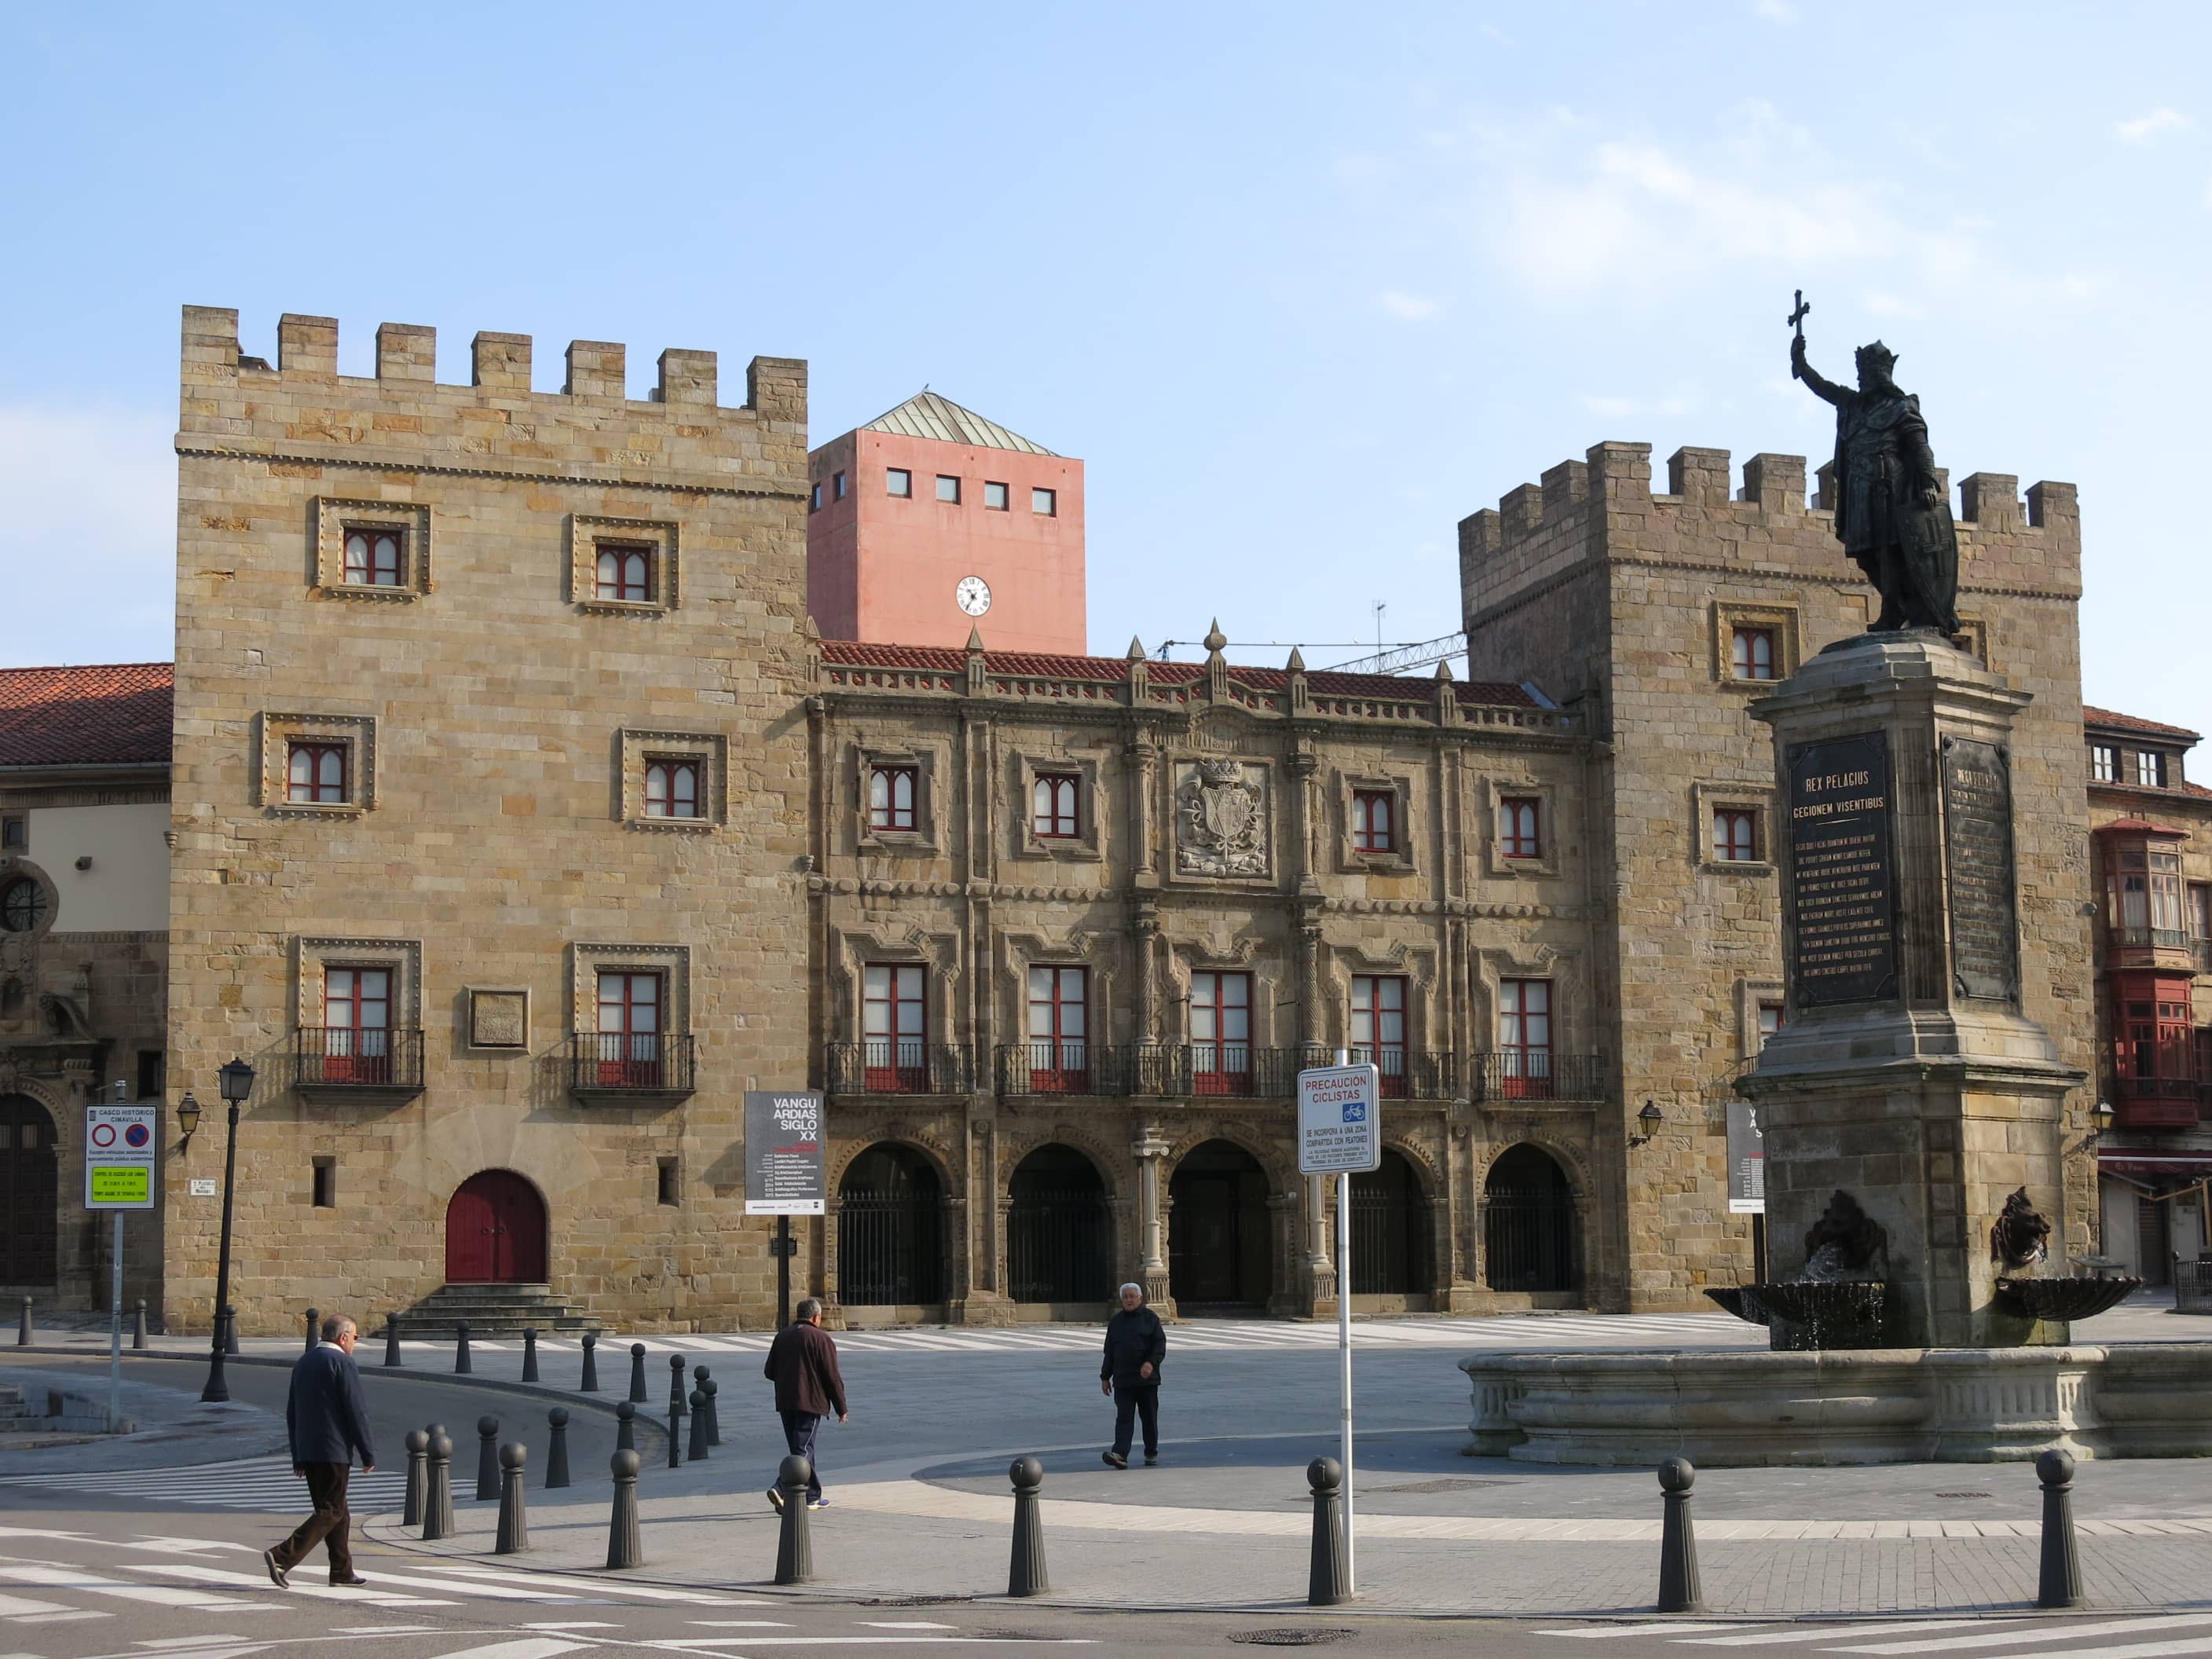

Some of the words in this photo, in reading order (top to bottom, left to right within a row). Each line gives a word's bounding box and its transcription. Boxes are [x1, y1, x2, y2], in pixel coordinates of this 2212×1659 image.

[1806, 777, 1822, 793] REX
[1826, 771, 1870, 790] PELAGIUS
[1793, 803, 1833, 819] GEGIONEM
[1837, 797, 1884, 813] VISENTIBUS
[1306, 1074, 1367, 1091] PRECAUCIÓN
[1313, 1090, 1361, 1103] CICLISTAS
[773, 1098, 817, 1108] VANGU
[773, 1109, 818, 1119] ARDIAS
[780, 1119, 818, 1130] SIGLO
[800, 1130, 817, 1141] XX
